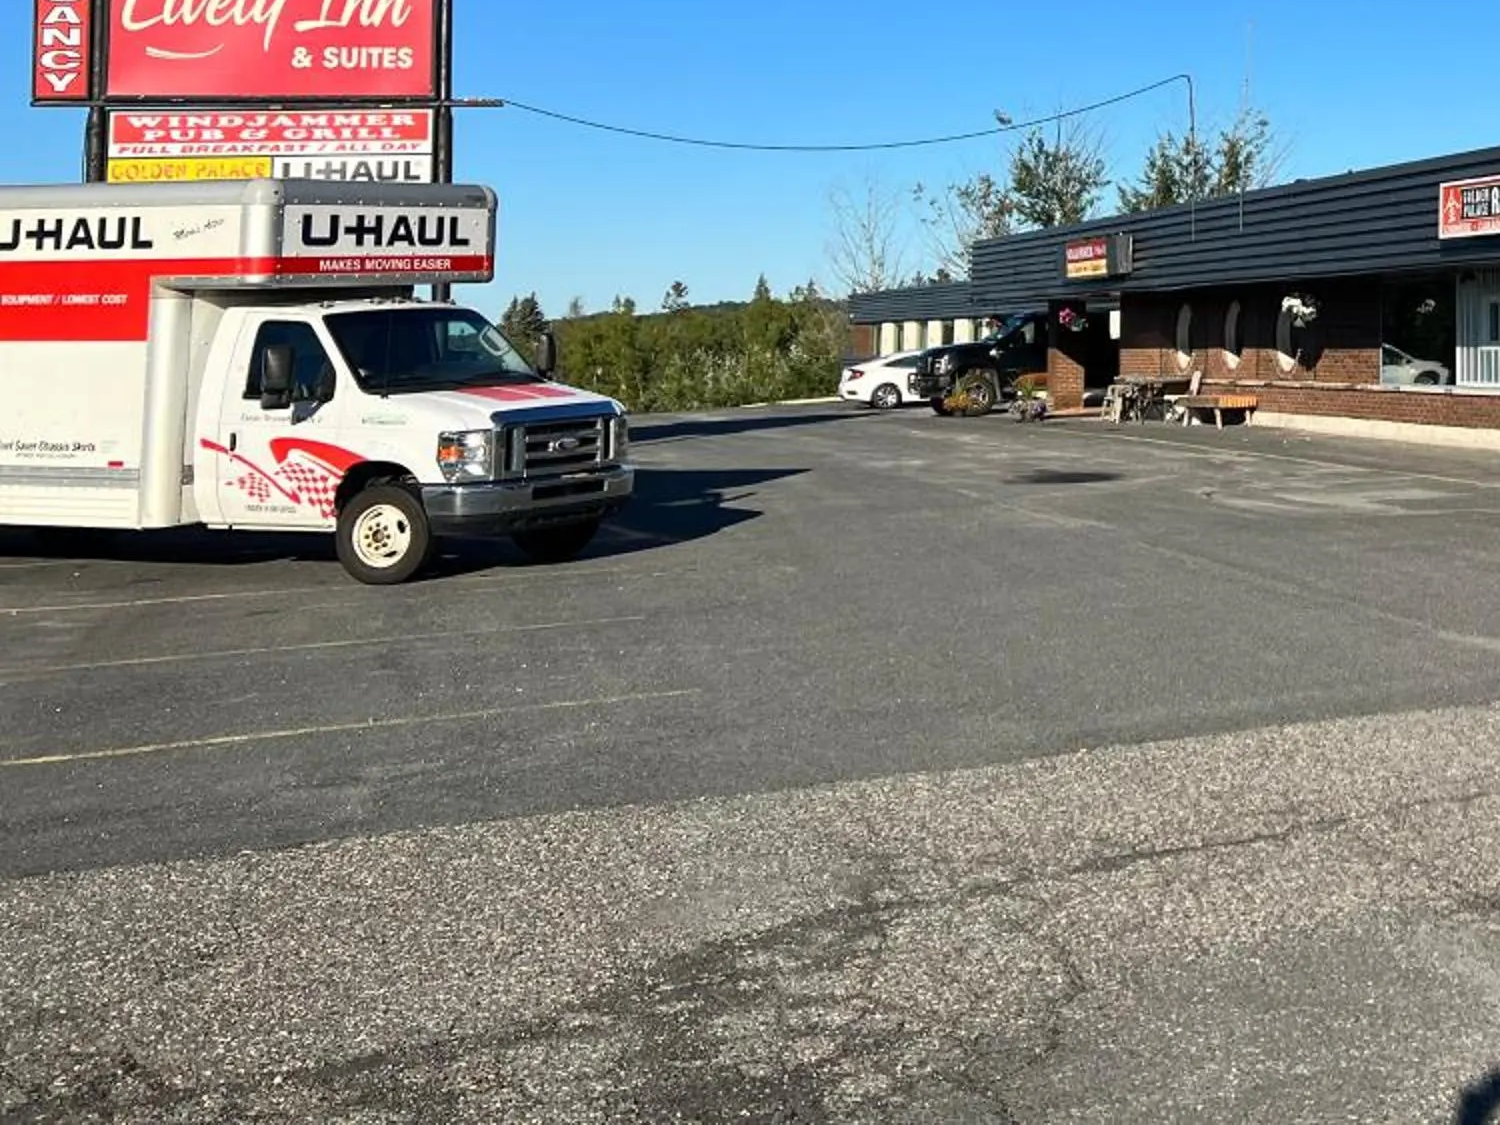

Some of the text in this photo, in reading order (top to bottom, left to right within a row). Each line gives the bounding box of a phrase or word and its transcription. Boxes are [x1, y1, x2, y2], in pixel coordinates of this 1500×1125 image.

[291, 46, 414, 69] & SUITES
[127, 114, 415, 127] WINDJAMMER
[143, 127, 402, 141] PUB & GRILL
[180, 143, 306, 154] BREAKFAST
[334, 143, 371, 152] ALL
[381, 142, 421, 151] DAY
[110, 161, 187, 181] GOLDEN
[301, 214, 471, 247] U-HAUL
[319, 259, 451, 272] MAKES MOVING EASIER
[102, 294, 128, 305] COST
